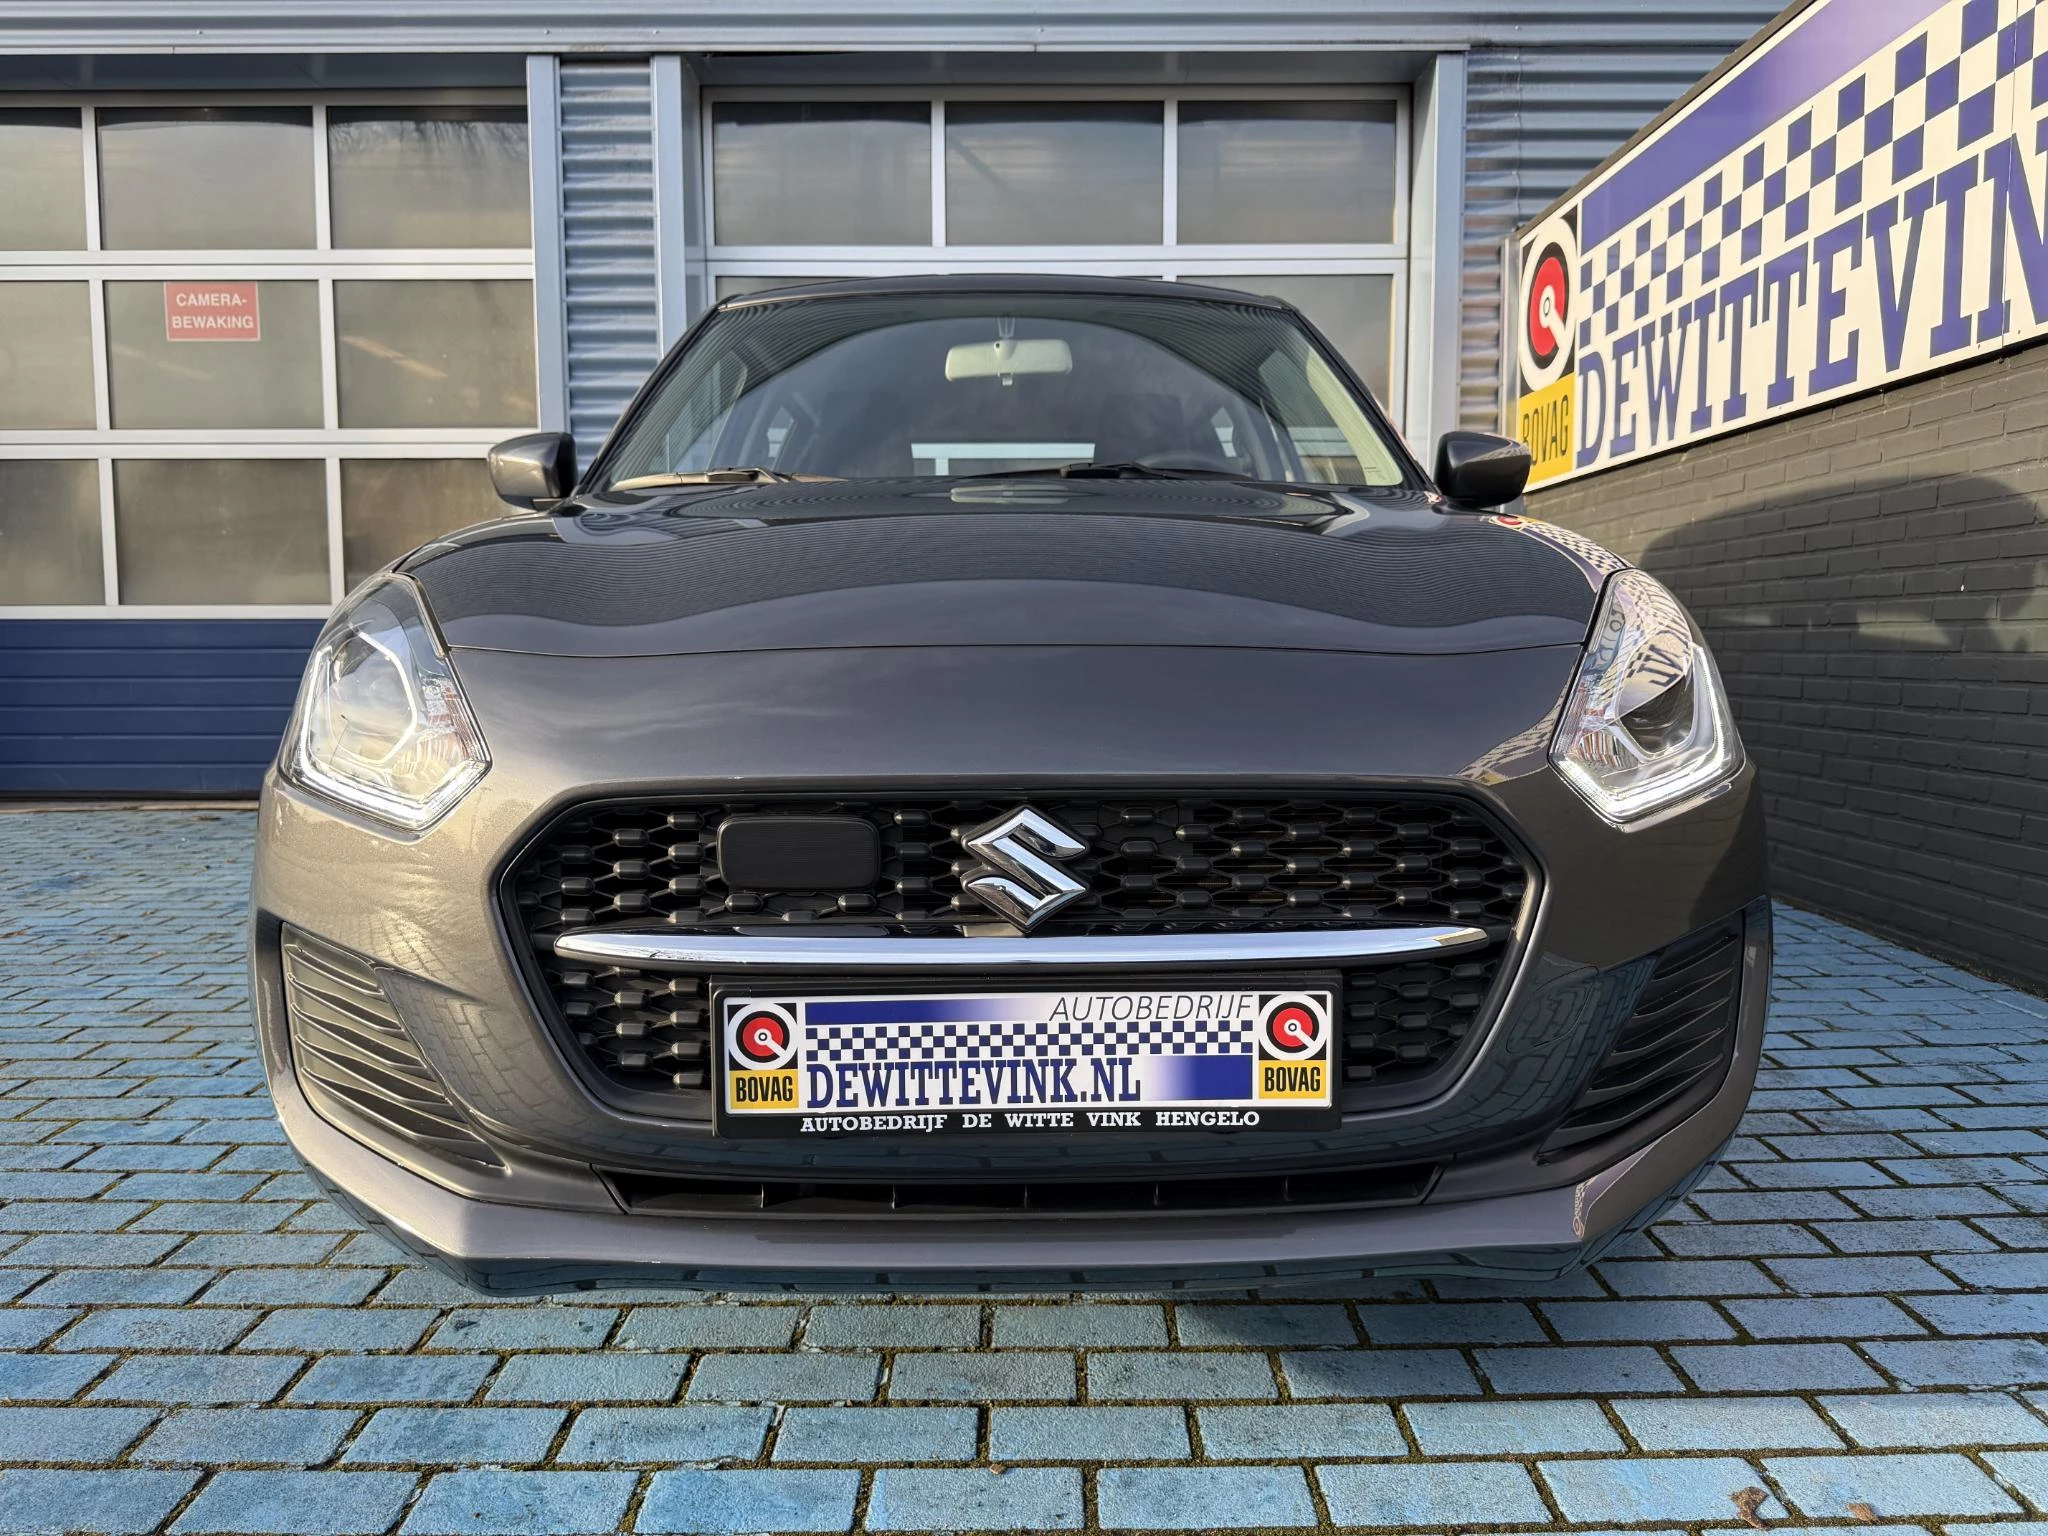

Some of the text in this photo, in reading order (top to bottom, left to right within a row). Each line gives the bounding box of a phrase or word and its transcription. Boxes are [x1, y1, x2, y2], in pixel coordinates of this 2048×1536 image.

[176, 292, 248, 307] CAMERA-
[171, 315, 254, 329] BEWAKING
[1049, 994, 1254, 1021] AUTOBEDRIJF
[735, 1075, 793, 1102] BOVAG
[806, 1057, 1141, 1109] DEWITTEVINK.NL
[1263, 1066, 1321, 1092] BOVAG
[800, 1110, 1260, 1133] AUTOBEDRIJF DE WITTE VINK HENGELO
